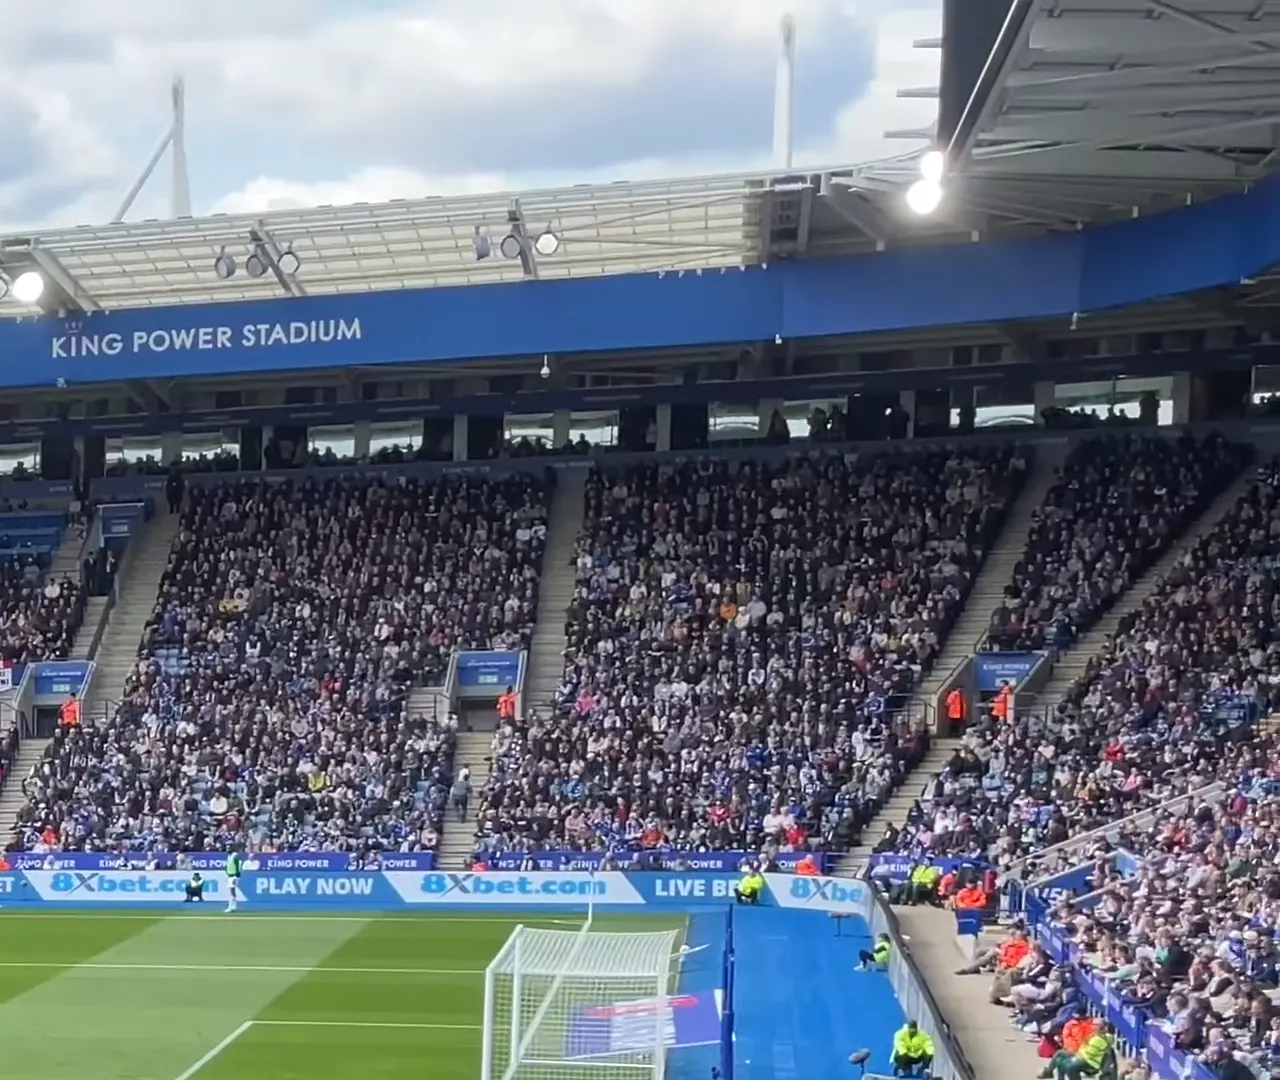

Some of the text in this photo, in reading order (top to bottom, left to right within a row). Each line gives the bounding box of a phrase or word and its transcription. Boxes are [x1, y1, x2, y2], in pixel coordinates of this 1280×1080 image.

[52, 318, 361, 358] KING POWER STADIUM
[268, 859, 329, 868] KING POWER
[257, 878, 373, 895] PLAY NOW
[420, 873, 606, 899] 8Xbet.com
[655, 879, 705, 896] LIVE
